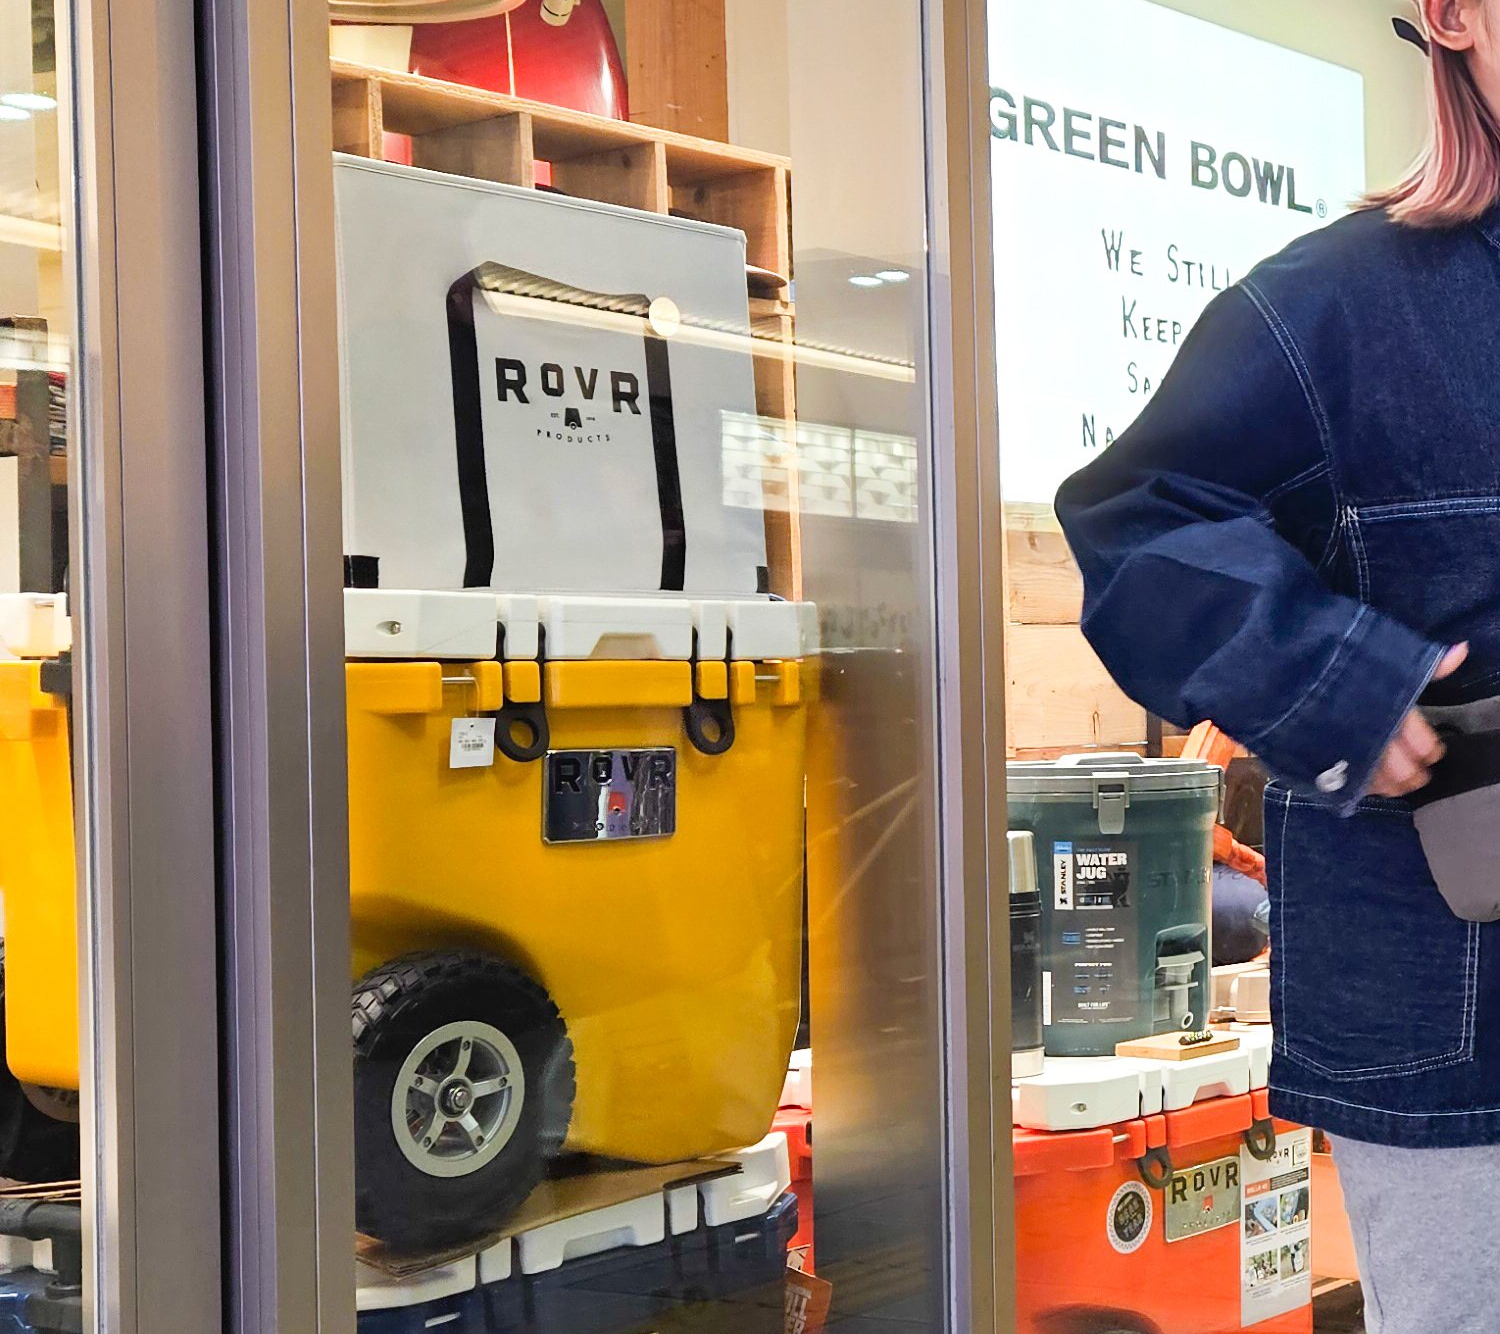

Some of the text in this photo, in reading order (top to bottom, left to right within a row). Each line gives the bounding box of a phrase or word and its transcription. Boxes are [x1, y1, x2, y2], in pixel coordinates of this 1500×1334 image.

[989, 86, 1166, 180] GREEN
[1101, 228, 1144, 277] WE
[1122, 295, 1182, 345] KEEP
[495, 357, 641, 415] ROVR
[1127, 361, 1164, 395] SA
[537, 428, 611, 444] PRODUCTS
[1081, 413, 1115, 448] NA
[554, 752, 674, 794] ROVR
[1075, 852, 1127, 866] WATER
[1075, 867, 1107, 880] JUG
[1171, 1161, 1239, 1205] ROVR
